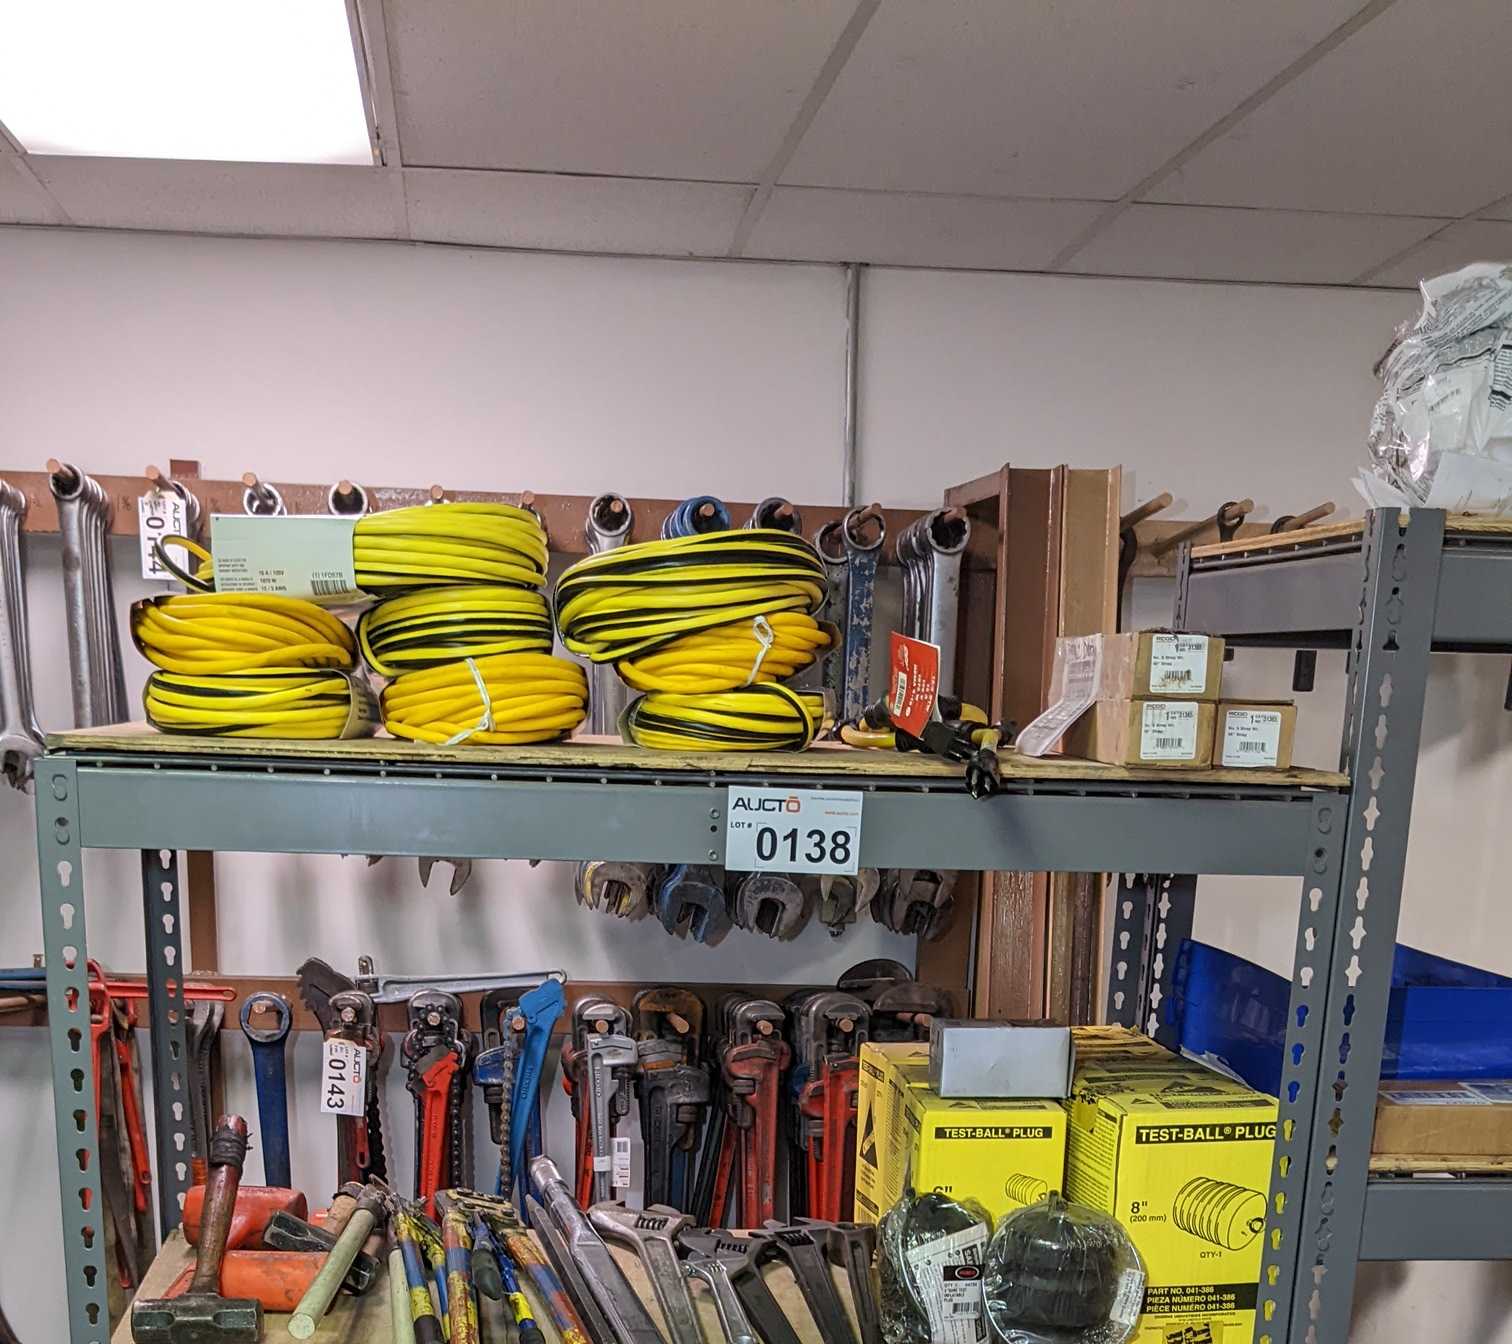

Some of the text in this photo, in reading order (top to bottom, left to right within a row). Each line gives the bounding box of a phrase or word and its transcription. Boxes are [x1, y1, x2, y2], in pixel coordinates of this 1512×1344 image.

[172, 502, 181, 536] AUCT
[730, 821, 746, 829] LOT
[756, 827, 851, 865] 0138
[327, 1058, 346, 1109] 0143
[1012, 1127, 1044, 1138] PLUG
[1235, 1124, 1277, 1139] PLUG
[1129, 1214, 1167, 1223] (200 mm)
[1147, 1287, 1169, 1296] PART
[1170, 1287, 1185, 1295] NO.
[1146, 1296, 1170, 1304] PIEZA
